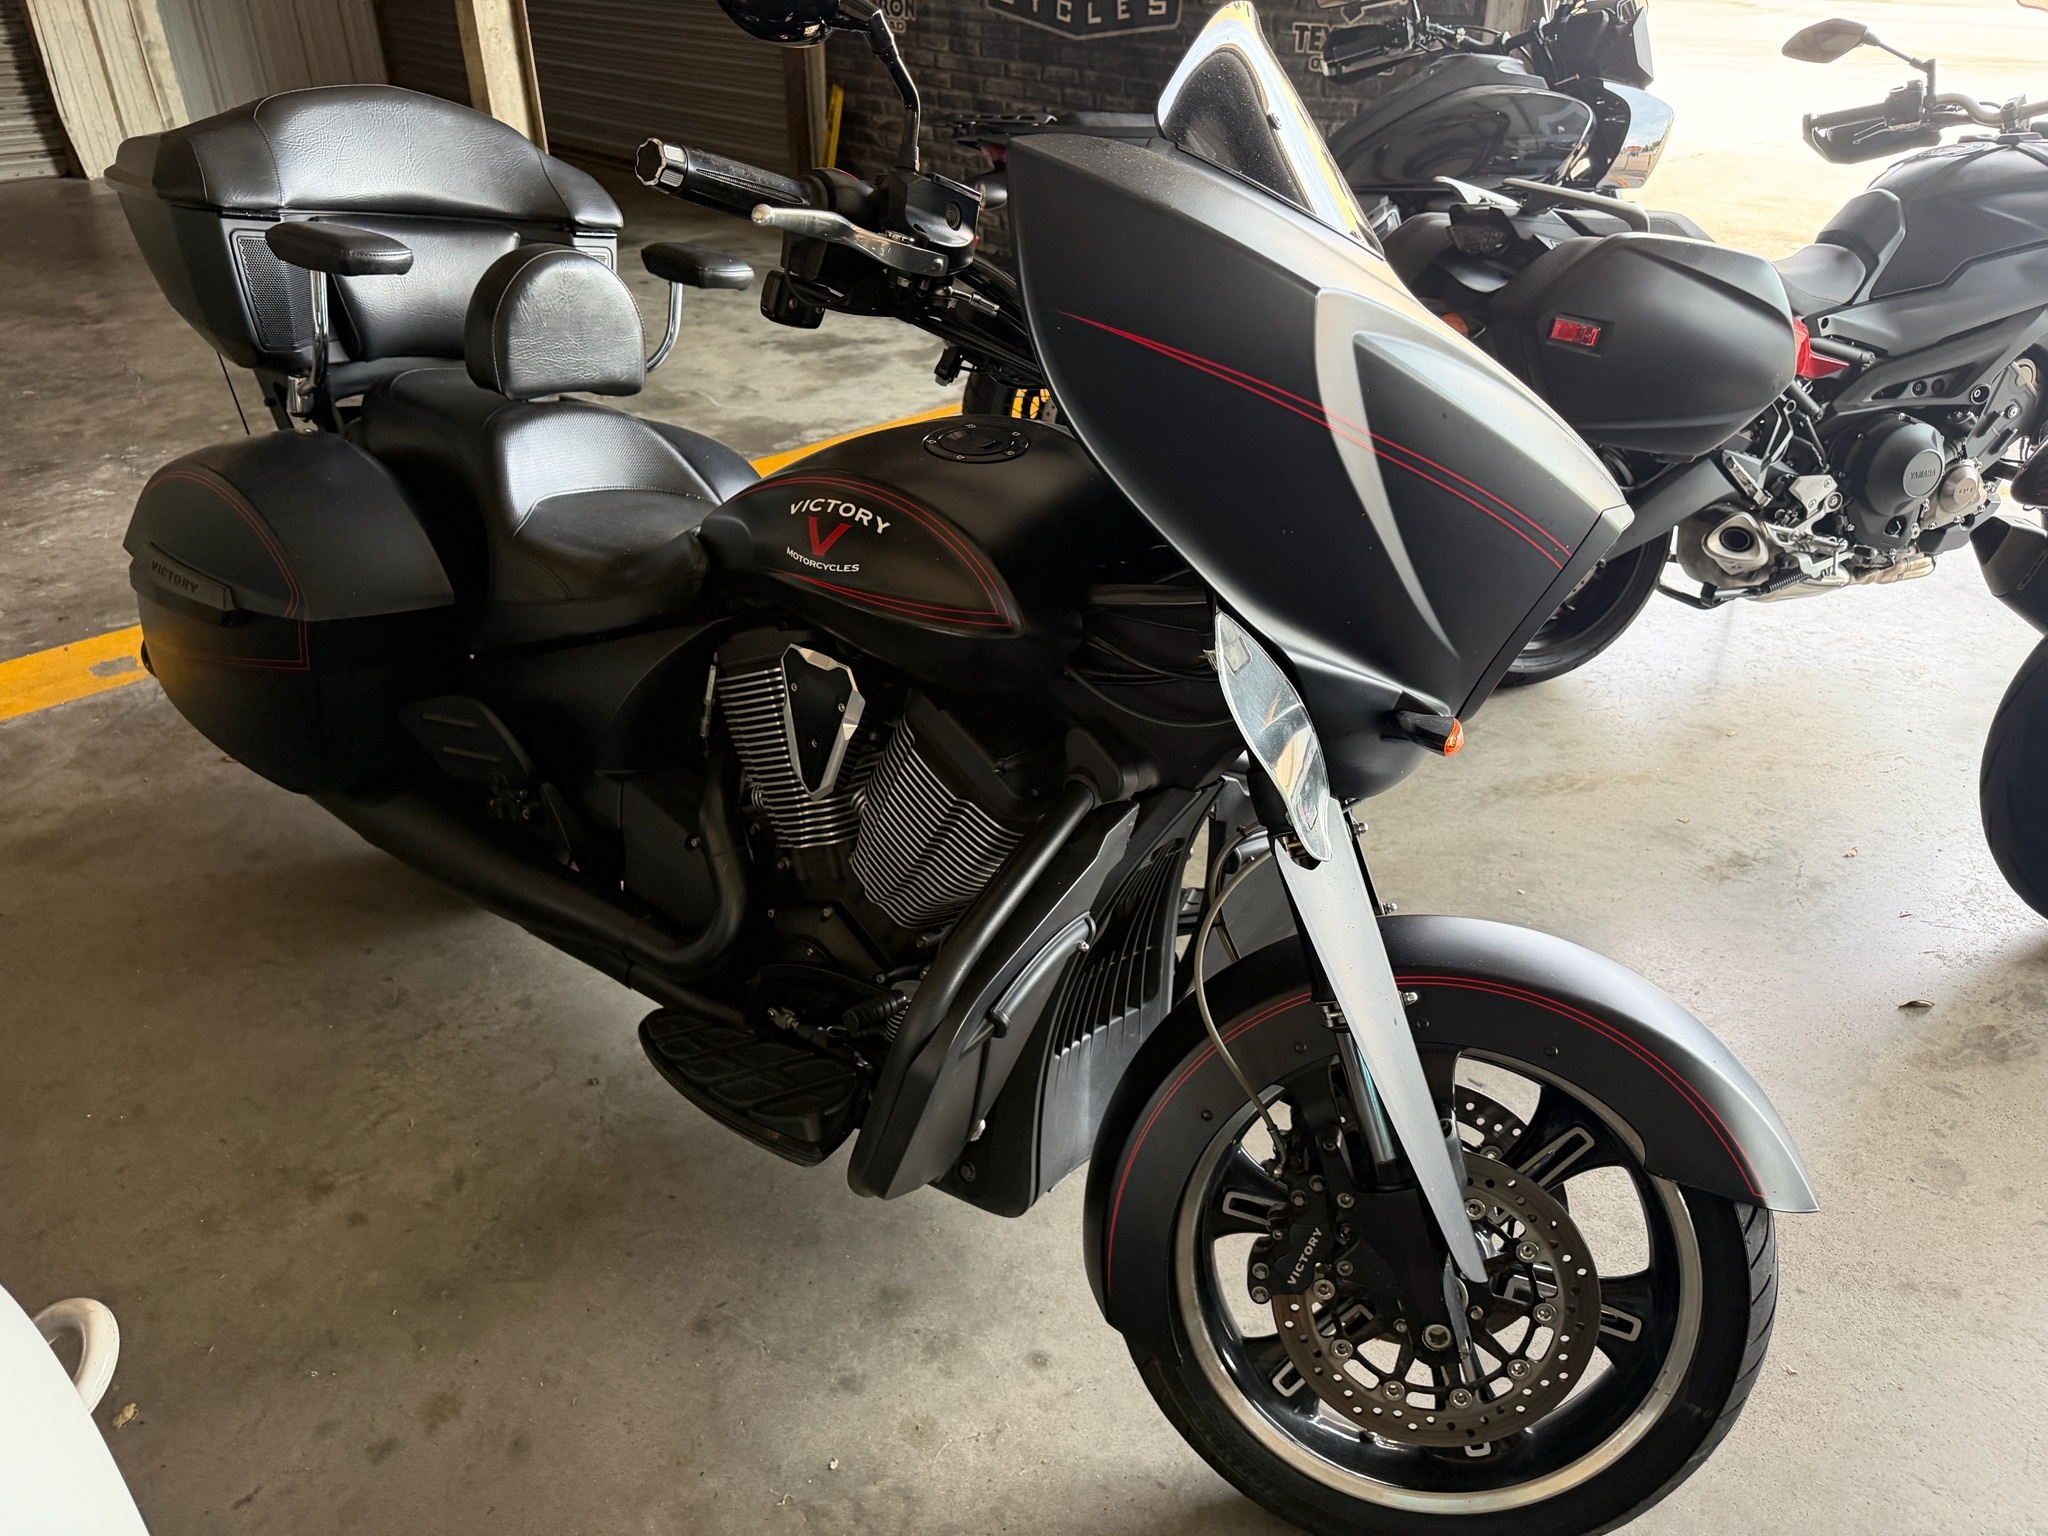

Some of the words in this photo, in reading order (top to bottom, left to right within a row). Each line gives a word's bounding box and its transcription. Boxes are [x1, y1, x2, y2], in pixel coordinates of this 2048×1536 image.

[1000, 0, 1167, 24] CLES
[1910, 468, 1936, 480] YAMAHA
[790, 498, 891, 534] VICTORY
[808, 515, 852, 557] V
[786, 546, 860, 573] MOTORCYCLES
[150, 560, 199, 593] VICTORY
[1287, 1227, 1322, 1285] VICTORY
